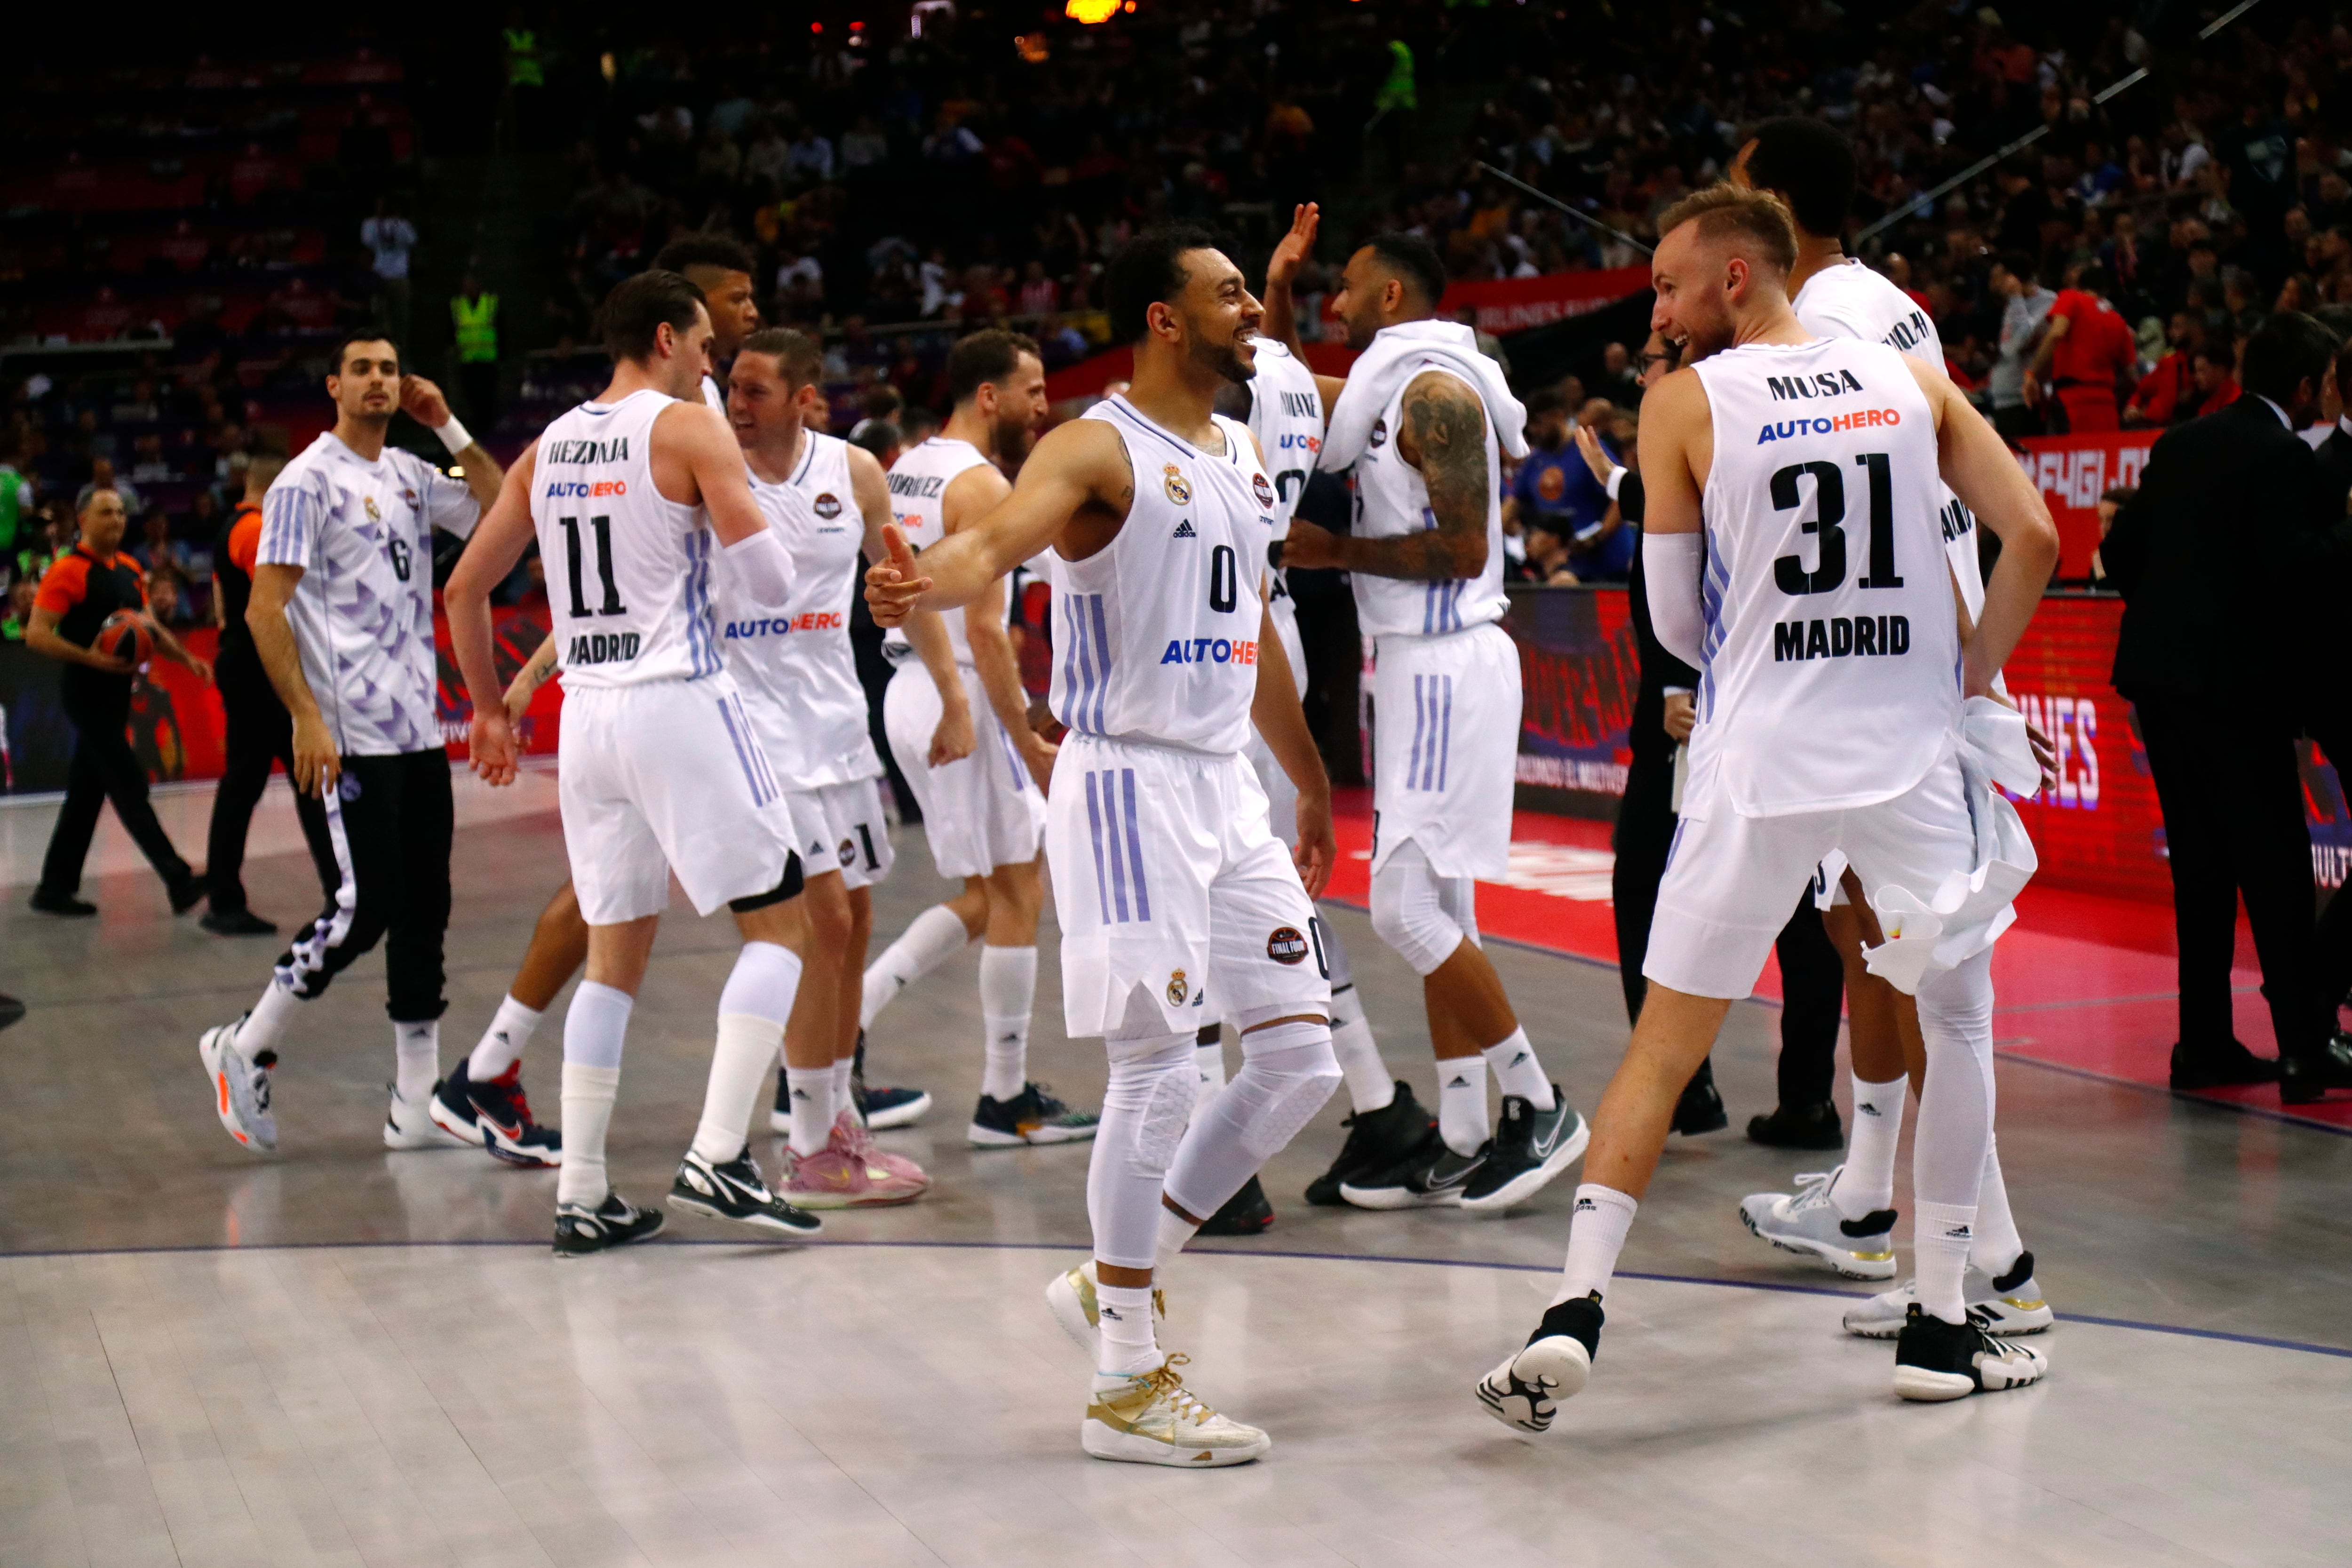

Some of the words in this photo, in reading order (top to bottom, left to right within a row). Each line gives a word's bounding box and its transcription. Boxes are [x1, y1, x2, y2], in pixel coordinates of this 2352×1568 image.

[1767, 369, 1863, 401] MUSA
[1757, 409, 1900, 445] AUTOHERO
[1770, 453, 1904, 596] 31
[389, 539, 410, 581] 6
[559, 515, 627, 619] 11
[1209, 544, 1237, 613] 0
[1775, 615, 1910, 662] MADRID
[854, 823, 881, 872] 1
